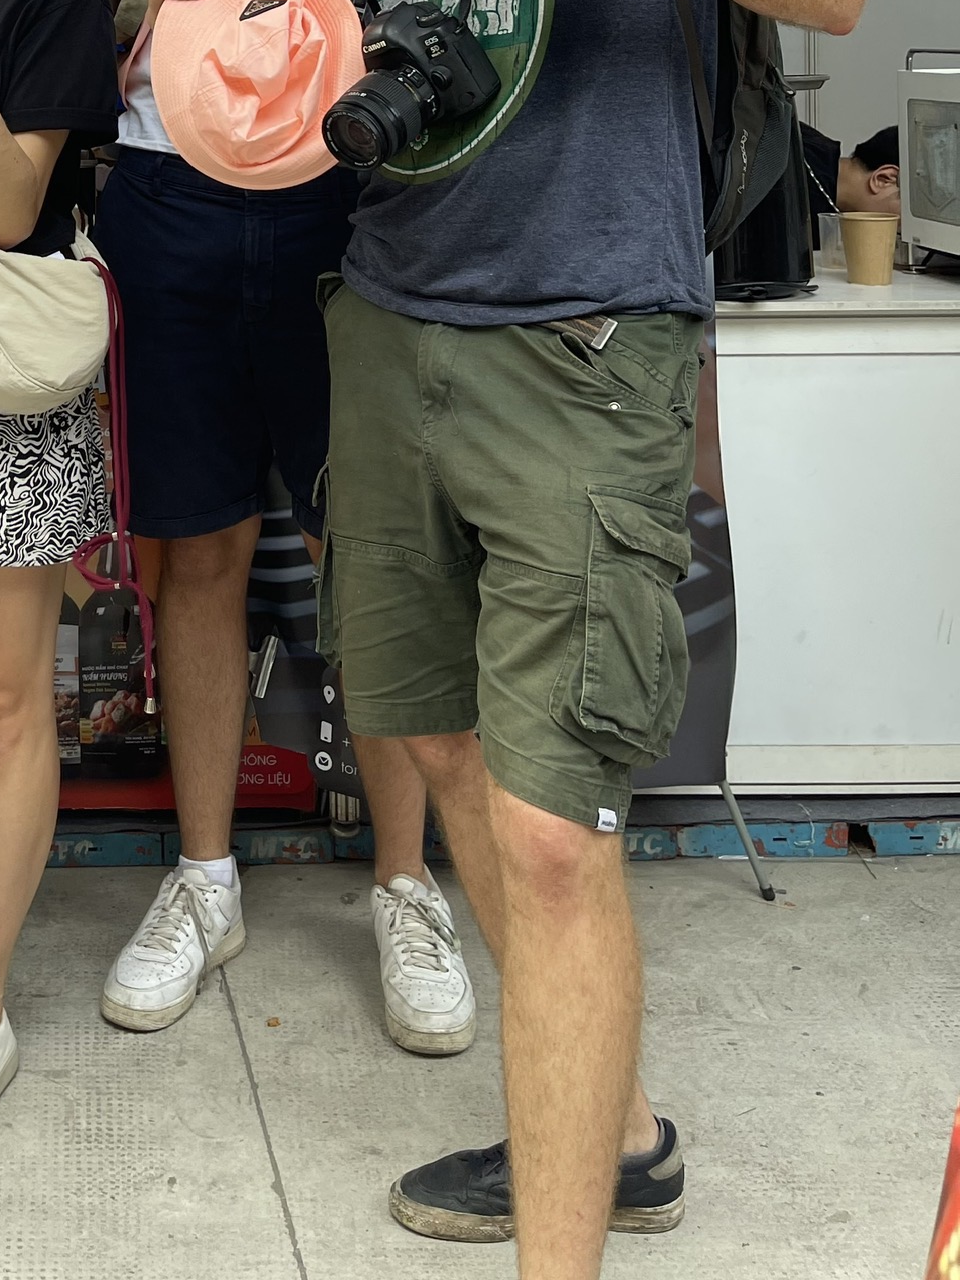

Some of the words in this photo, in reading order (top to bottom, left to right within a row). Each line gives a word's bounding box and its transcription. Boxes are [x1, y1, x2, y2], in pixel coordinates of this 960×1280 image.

[363, 40, 387, 53] Canon
[424, 35, 439, 46] EOS
[240, 753, 277, 766] HÔNG
[268, 771, 291, 786] LIỆU
[626, 833, 663, 855] TC
